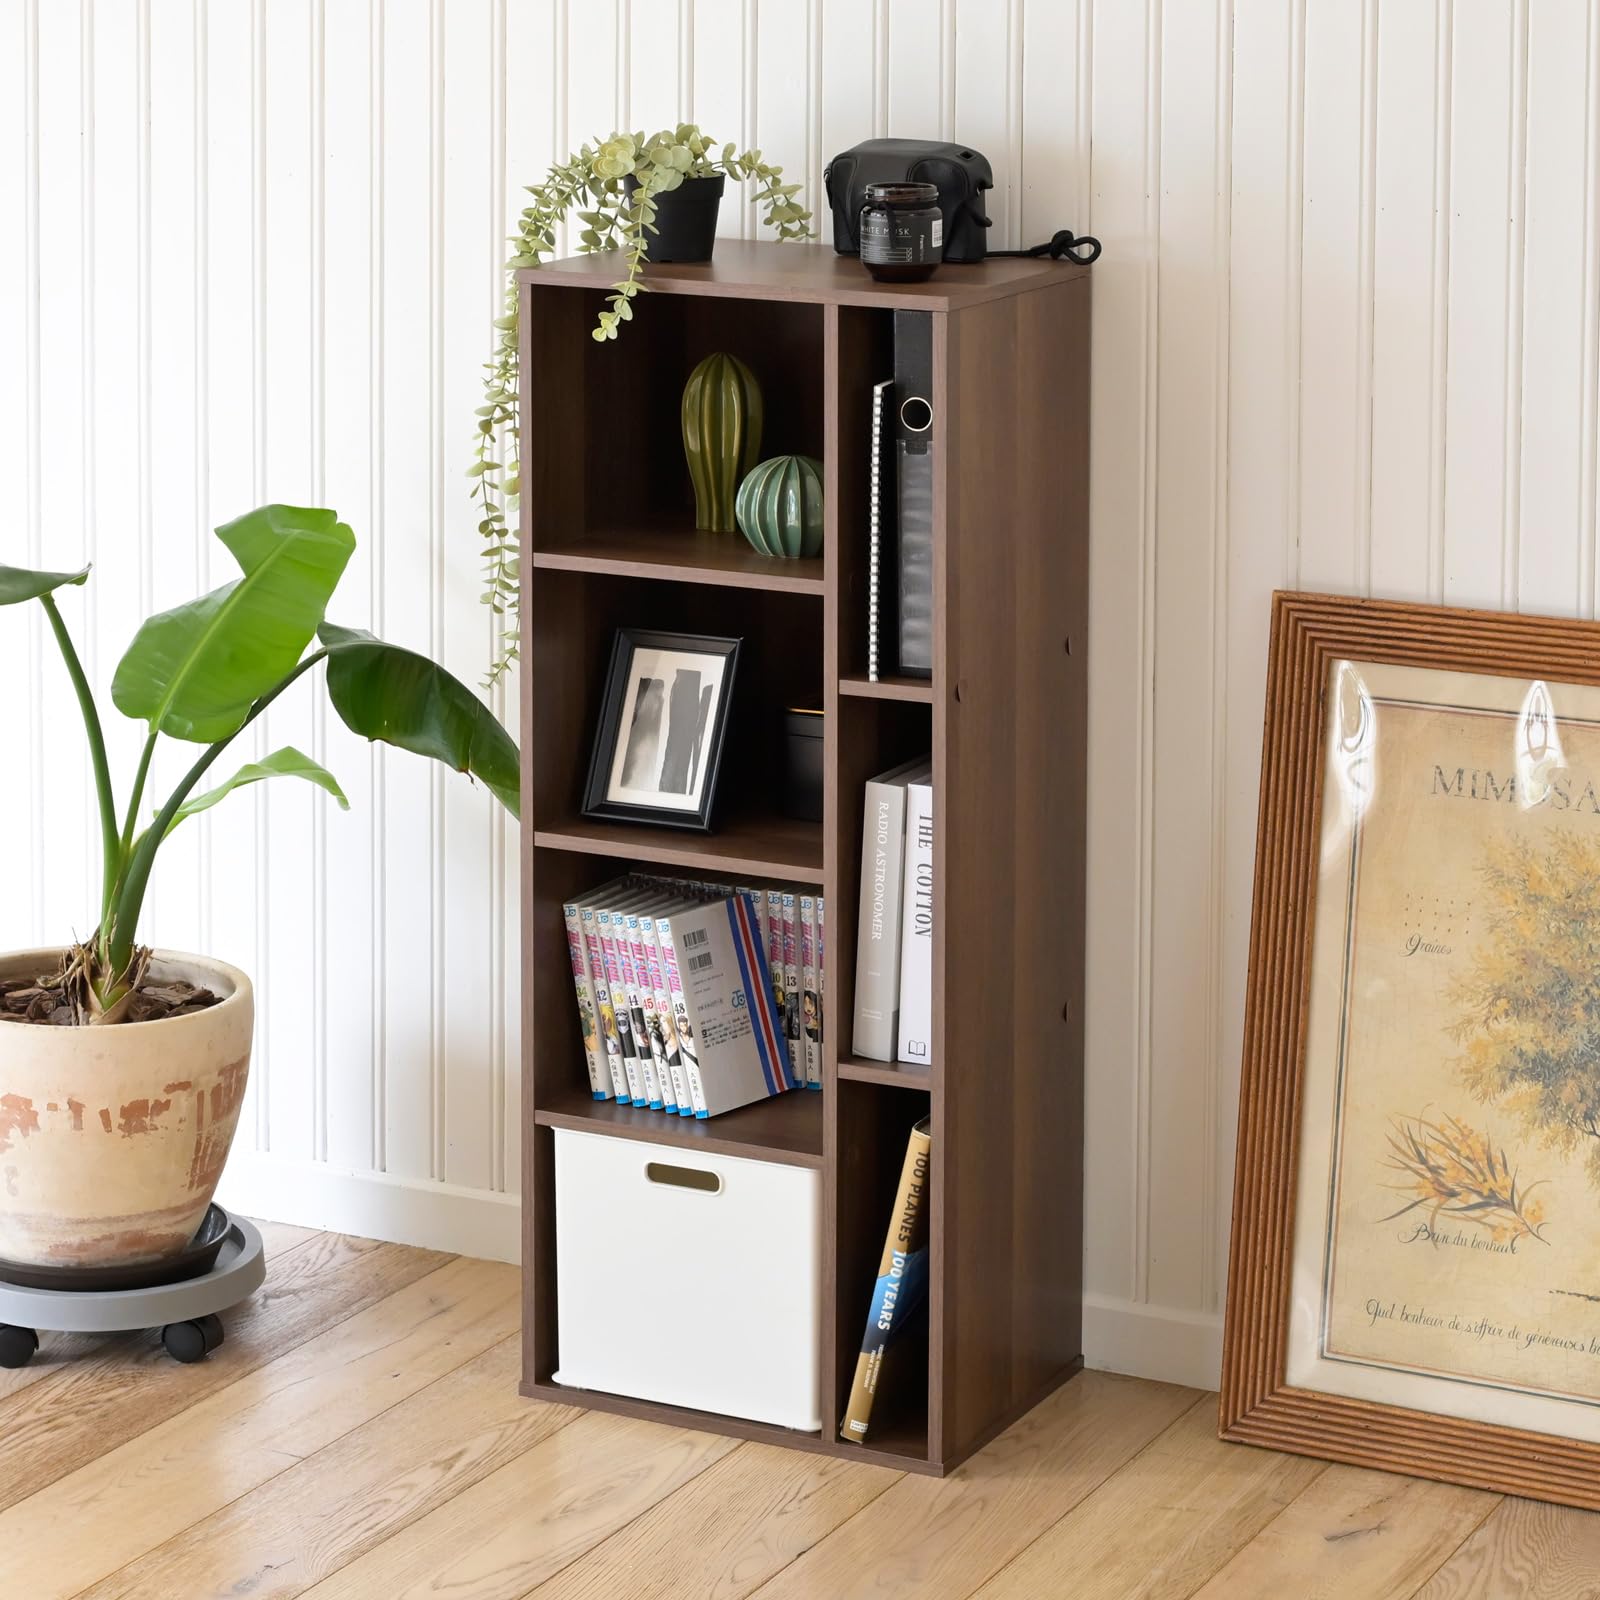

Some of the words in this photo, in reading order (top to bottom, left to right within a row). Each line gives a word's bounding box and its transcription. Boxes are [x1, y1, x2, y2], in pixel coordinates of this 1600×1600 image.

[883, 227, 910, 235] MSK
[1431, 764, 1600, 814] MIMSA
[877, 801, 889, 845] RADIO
[918, 815, 932, 849] THE
[871, 848, 887, 941] ASTRONOMER
[914, 863, 932, 938] COTTON
[1398, 932, 1452, 957] Graines
[771, 972, 781, 982] 10
[786, 976, 797, 987] 13
[804, 977, 813, 988] 14
[596, 989, 608, 1001] 42
[643, 998, 654, 1010] 45
[656, 1001, 668, 1013] 46
[674, 1002, 686, 1015] 48
[912, 1151, 929, 1178] 100
[898, 1183, 923, 1243] PLANES
[1453, 1230, 1467, 1247] du
[889, 1249, 907, 1278] 100
[877, 1281, 900, 1331] YEARS
[1366, 1299, 1395, 1328] Quel
[1399, 1304, 1444, 1327] bonheur
[1448, 1314, 1460, 1331] de
[1508, 1325, 1521, 1340] de
[1516, 1327, 1585, 1352] généreuses
